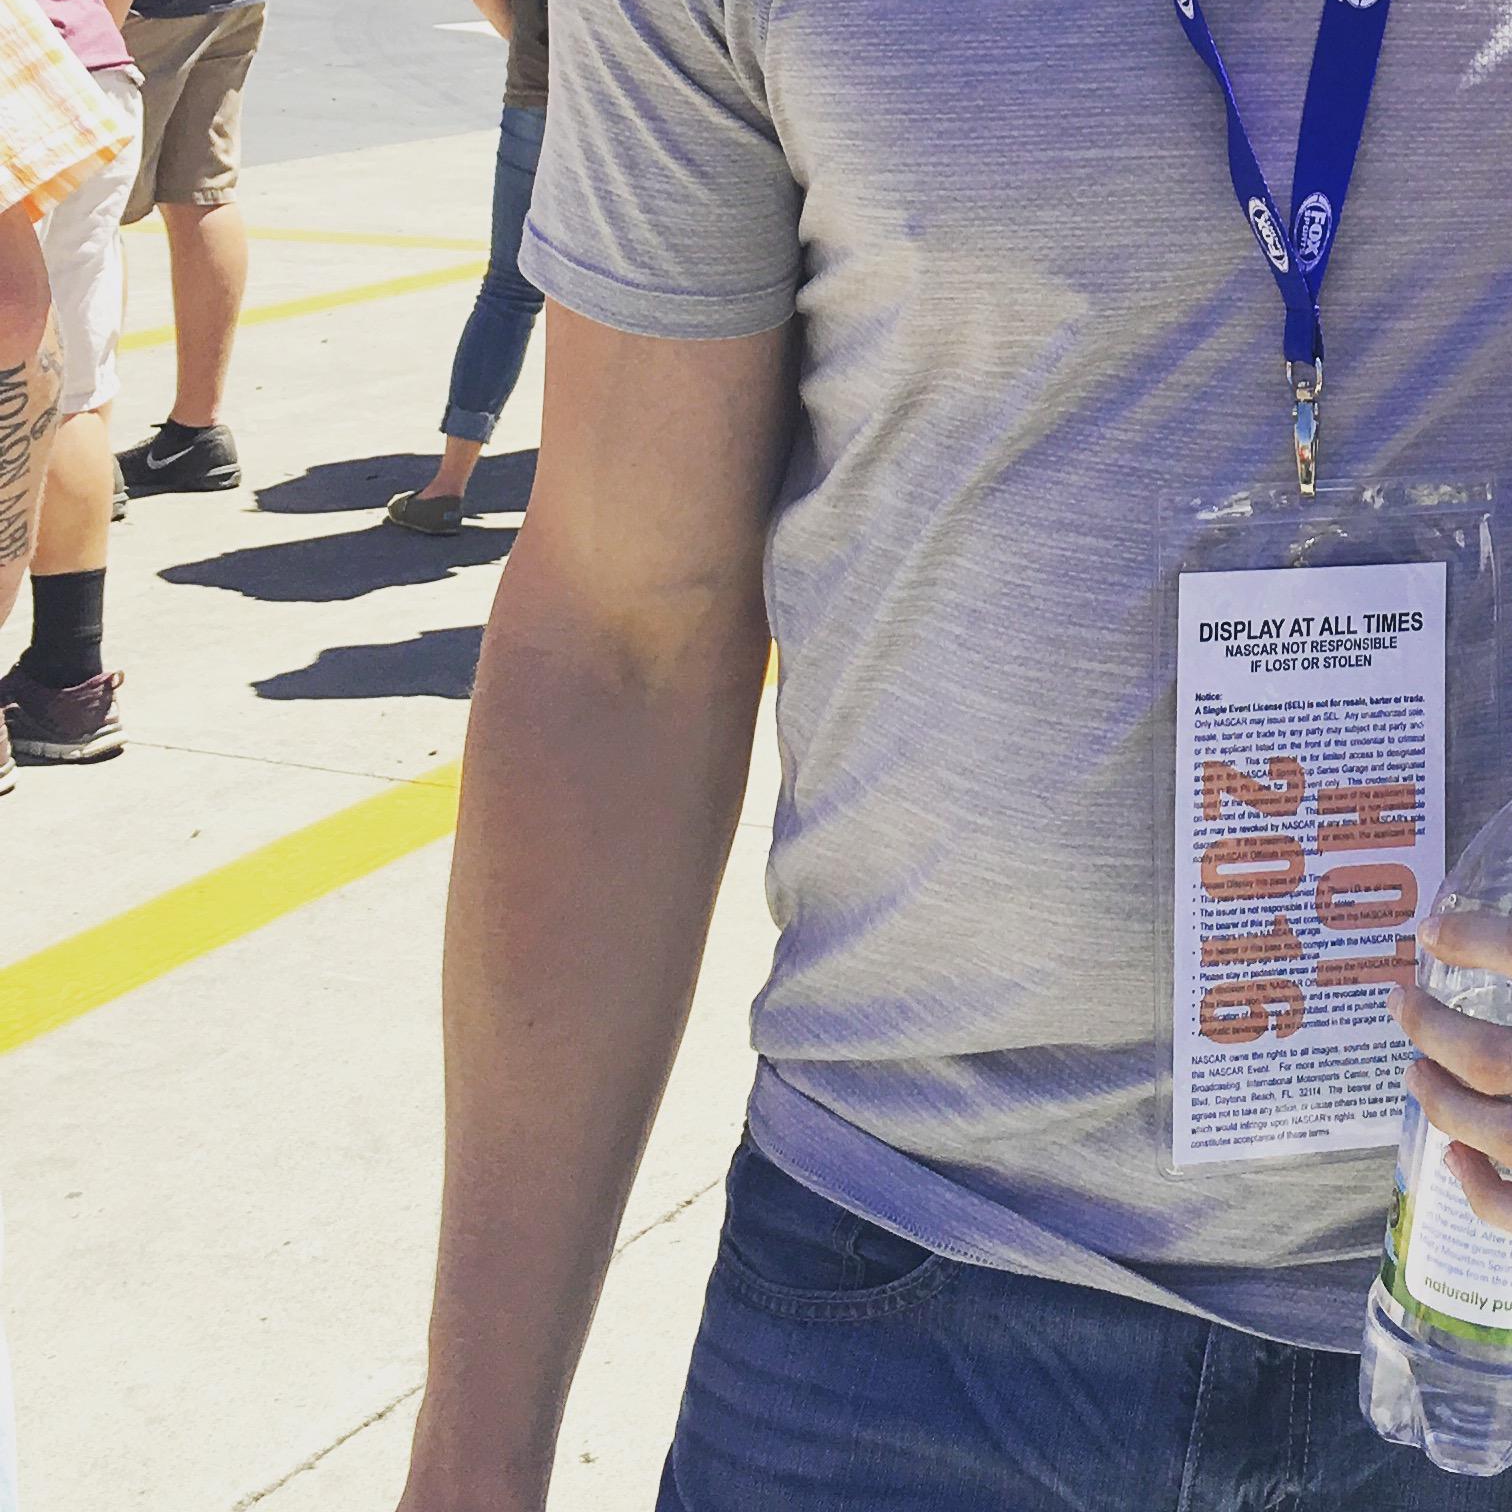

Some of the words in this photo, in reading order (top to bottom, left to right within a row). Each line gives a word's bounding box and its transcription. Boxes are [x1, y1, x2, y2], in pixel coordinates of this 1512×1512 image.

[1305, 210, 1327, 256] FOX
[1199, 618, 1285, 643] DISPLAY
[1289, 617, 1315, 639] AT
[1319, 615, 1357, 637] ALL
[1363, 611, 1424, 635] TIMES
[1225, 642, 1278, 658] NASCAR
[1281, 640, 1308, 655] NOT
[1310, 636, 1398, 653] RESPONSIBLE
[1250, 660, 1263, 673] IF
[1265, 657, 1299, 673] LOST
[1301, 656, 1320, 671] OR
[1322, 653, 1372, 670] STOLEN
[1196, 691, 1222, 701] Notice:
[1253, 702, 1282, 712] License
[1316, 700, 1328, 709] not
[1369, 696, 1391, 706] barter
[1195, 719, 1212, 730] Only
[1214, 717, 1247, 727] NASCAR
[1344, 711, 1358, 722] Any
[1282, 821, 1315, 830] NASCAR
[1316, 783, 1419, 998] HOT
[1201, 756, 1305, 1044] 2016
[1201, 909, 1214, 917] The
[1201, 922, 1214, 931] The
[1360, 910, 1392, 920] NASCAR
[1303, 940, 1328, 951] comply
[1331, 938, 1344, 947] with
[1360, 935, 1392, 945] NASCAR
[1309, 992, 1322, 1000] and
[1352, 1017, 1376, 1026] garage
[1192, 1055, 1226, 1065] NASCAR
[1373, 1041, 1386, 1049] and
[1192, 1070, 1204, 1079] this
[1209, 1067, 1243, 1077] NASCAR
[1299, 1088, 1320, 1097] 32114
[1389, 1108, 1402, 1116] this
[1424, 1275, 1488, 1310] naturally
